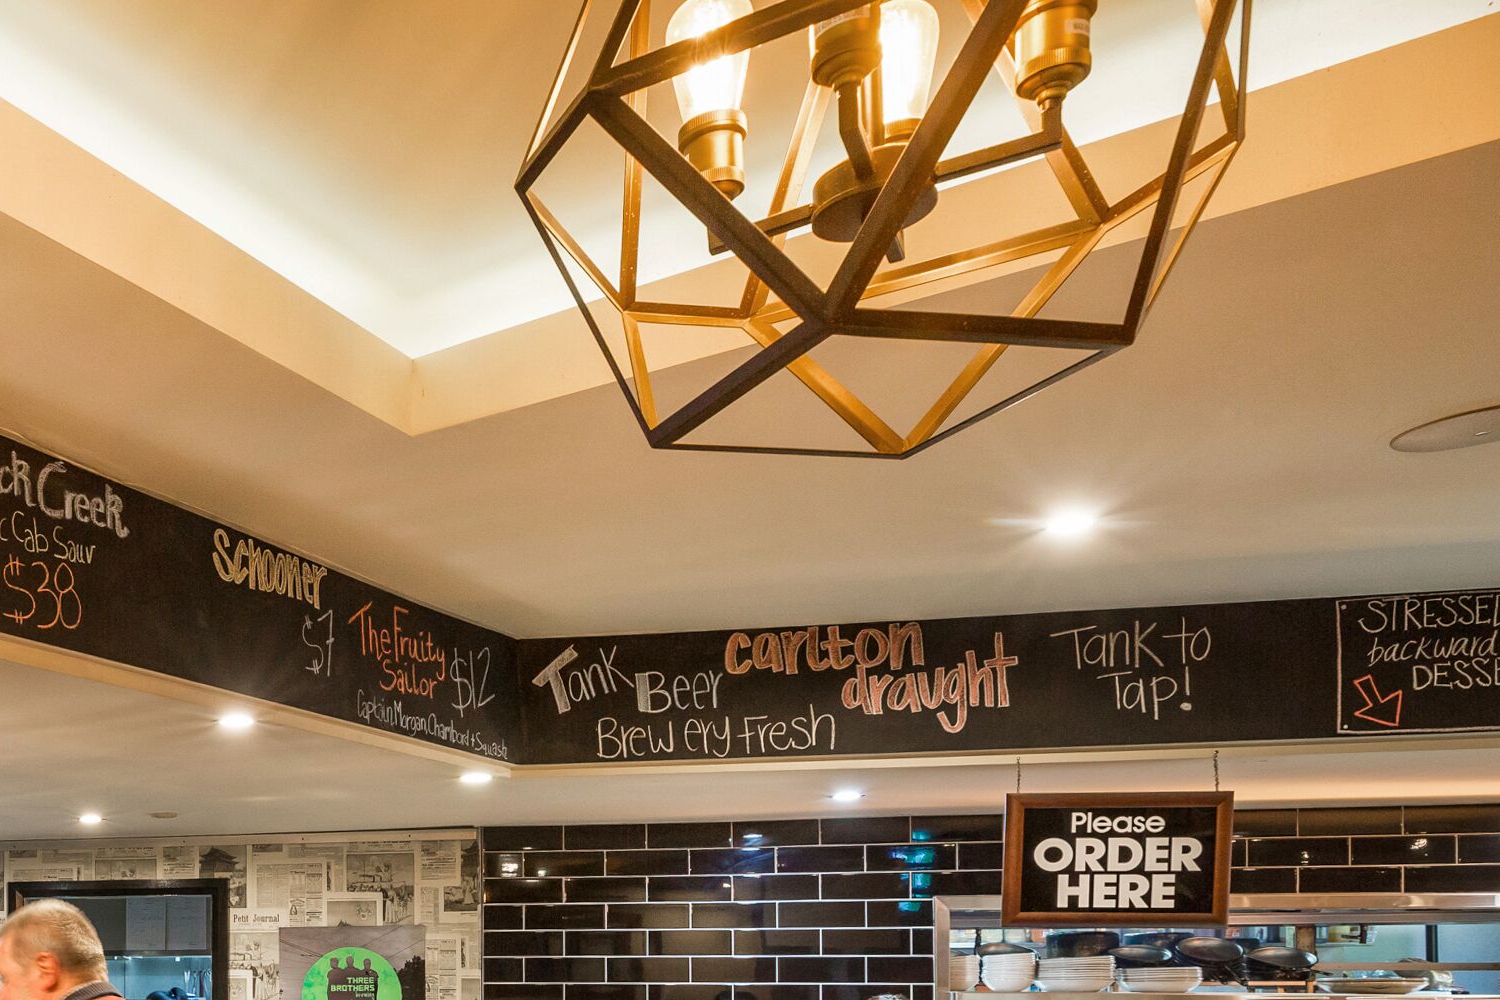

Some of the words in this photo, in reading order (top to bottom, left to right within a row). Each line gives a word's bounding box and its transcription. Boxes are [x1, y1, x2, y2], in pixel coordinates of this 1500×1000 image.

[38, 461, 130, 538] Creek
[12, 511, 48, 554] Cab
[53, 526, 96, 565] Sauv
[3, 554, 82, 630] $38
[212, 528, 328, 610] Schooner
[302, 609, 335, 678] $7
[348, 602, 391, 661] The
[393, 606, 446, 681] Fruity
[725, 622, 925, 675] carlton
[1050, 619, 1164, 670] Tank
[1162, 616, 1212, 665] to
[379, 660, 439, 699] Sailor
[450, 647, 496, 718] $12
[532, 644, 634, 714] Tank
[636, 669, 724, 713] Beer
[841, 632, 1019, 734] draught
[1097, 667, 1192, 721] Tap!
[737, 704, 836, 755] Fresh
[1071, 811, 1166, 834] Please
[1033, 837, 1203, 872] ORDER
[233, 914, 248, 922] Petit
[253, 914, 279, 922] Journal
[1056, 873, 1176, 909] HERE
